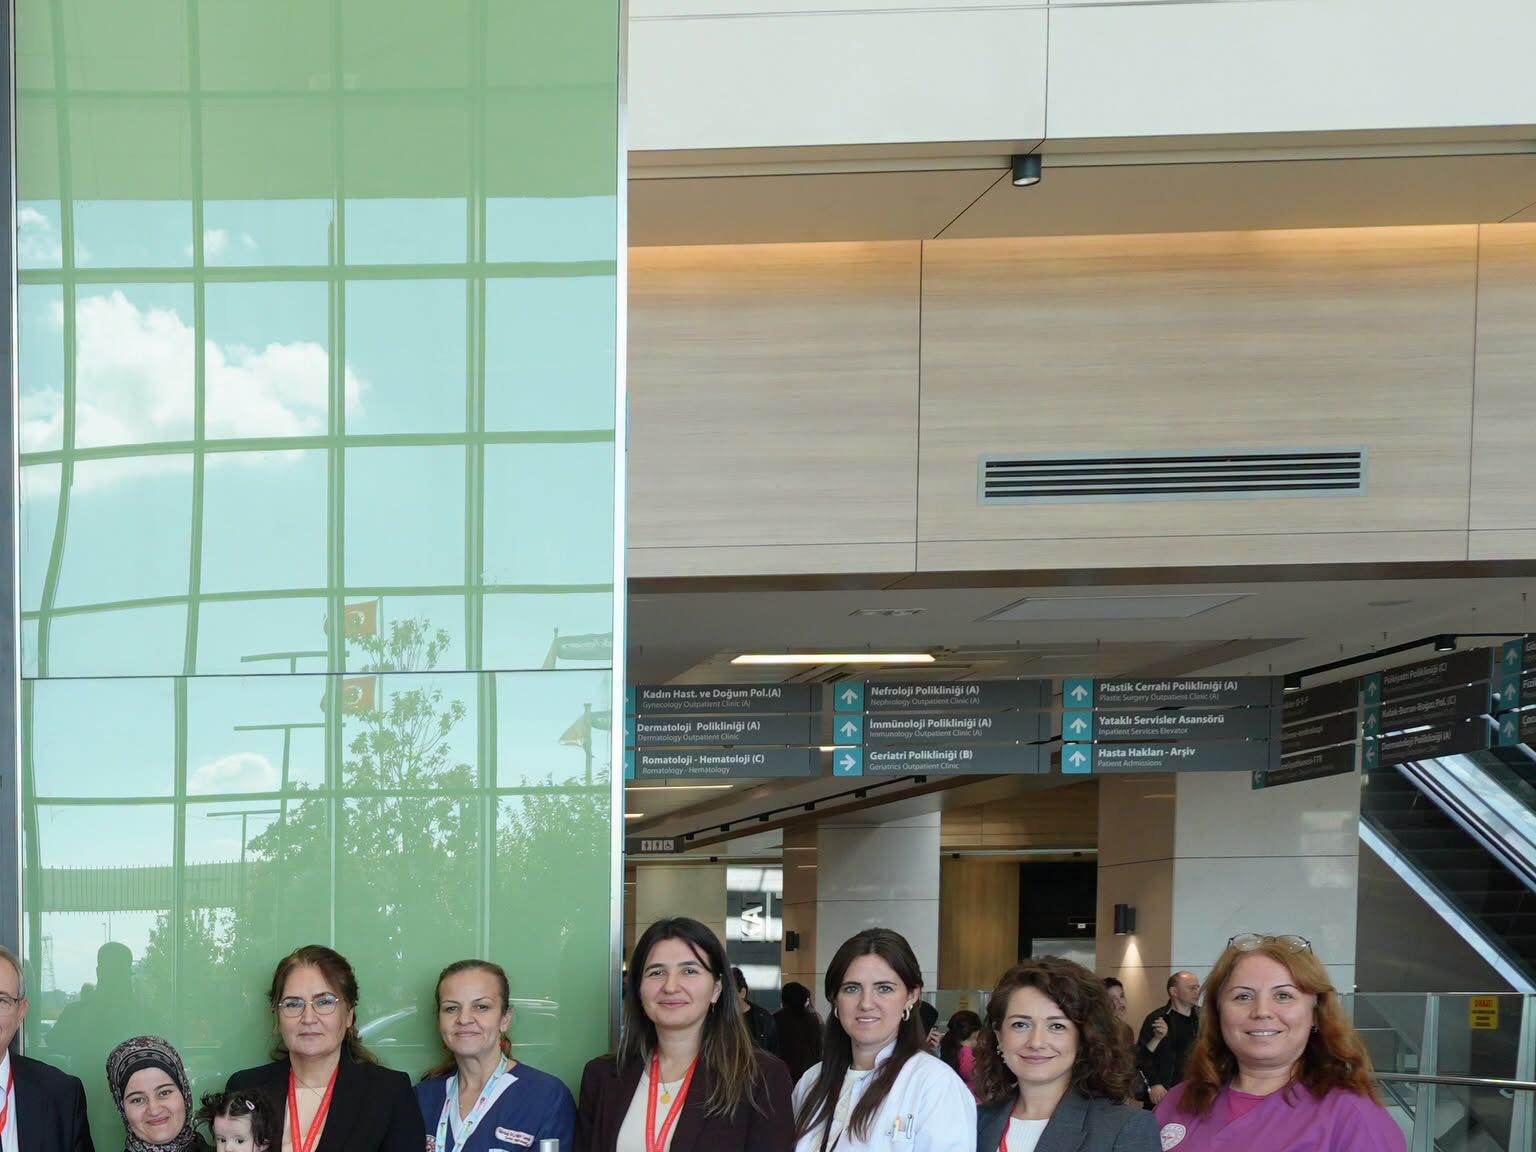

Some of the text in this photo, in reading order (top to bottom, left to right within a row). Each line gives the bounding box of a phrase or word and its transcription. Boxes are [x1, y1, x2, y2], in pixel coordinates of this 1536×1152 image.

[871, 686, 979, 697] Nefroloji Polikliniği (A)
[1100, 681, 1238, 692] Plastik Cerrahi Polikliniği (A)
[643, 690, 670, 699] Kadın
[673, 690, 697, 698] Hast.
[713, 689, 748, 699] Doğum
[870, 719, 992, 730] İmmünoloji Polikliniği (A)
[1099, 714, 1224, 725] Yataklı Servisler Asansörü
[637, 721, 760, 733] Dermatoloji Polikliniği (A)
[1099, 728, 1129, 736] Inpatient
[683, 734, 719, 742] Outpatient
[870, 750, 973, 761] Geriatri Polikliniği (B)
[1099, 747, 1196, 758] Hasta Hakları Arşiv
[643, 755, 764, 765] Romatoloji Hematoloji (C)
[870, 763, 901, 771] Geriatrics
[903, 763, 939, 771] Outpatient
